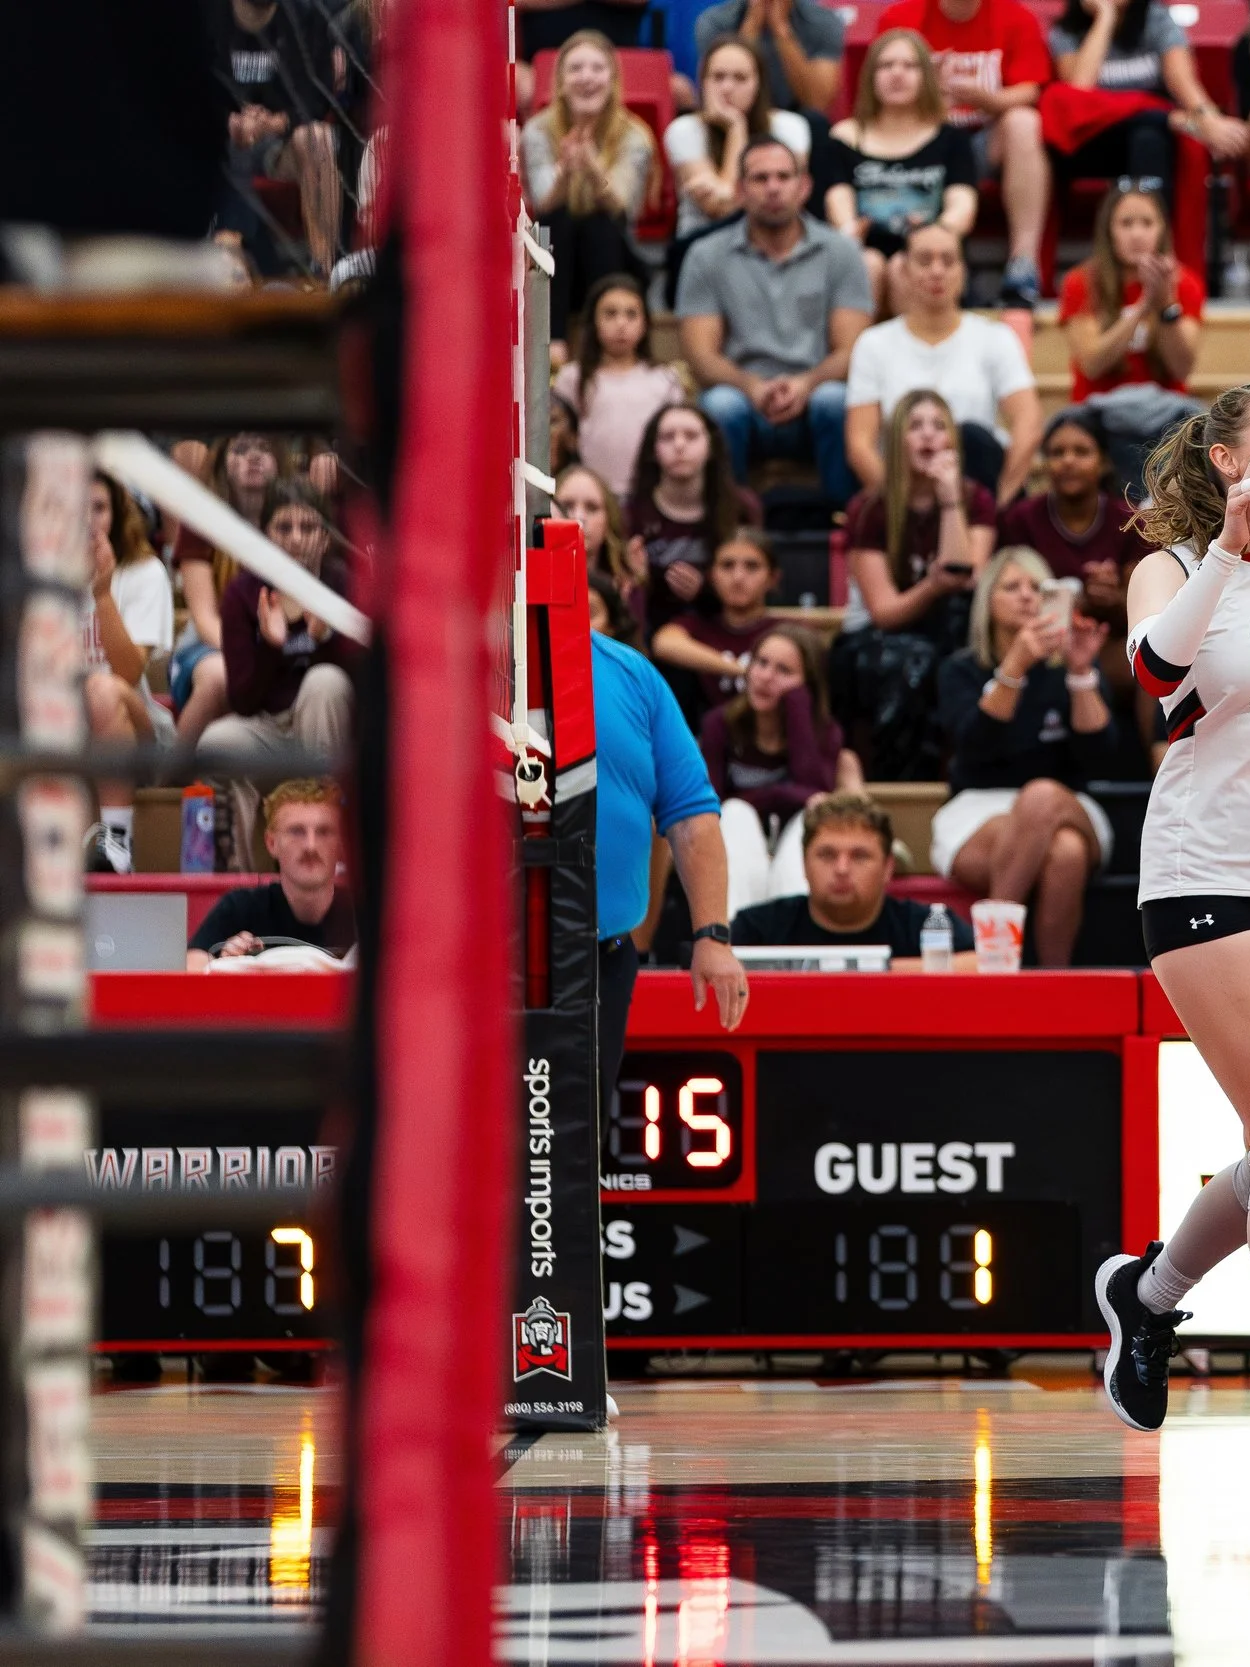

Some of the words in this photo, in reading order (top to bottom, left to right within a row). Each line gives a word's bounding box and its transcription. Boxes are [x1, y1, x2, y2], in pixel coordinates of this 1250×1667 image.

[523, 1057, 555, 1156] sports
[644, 1077, 731, 1168] 15
[814, 1141, 1015, 1194] GUEST
[524, 1159, 557, 1278] imports
[504, 1402, 532, 1415] (800)
